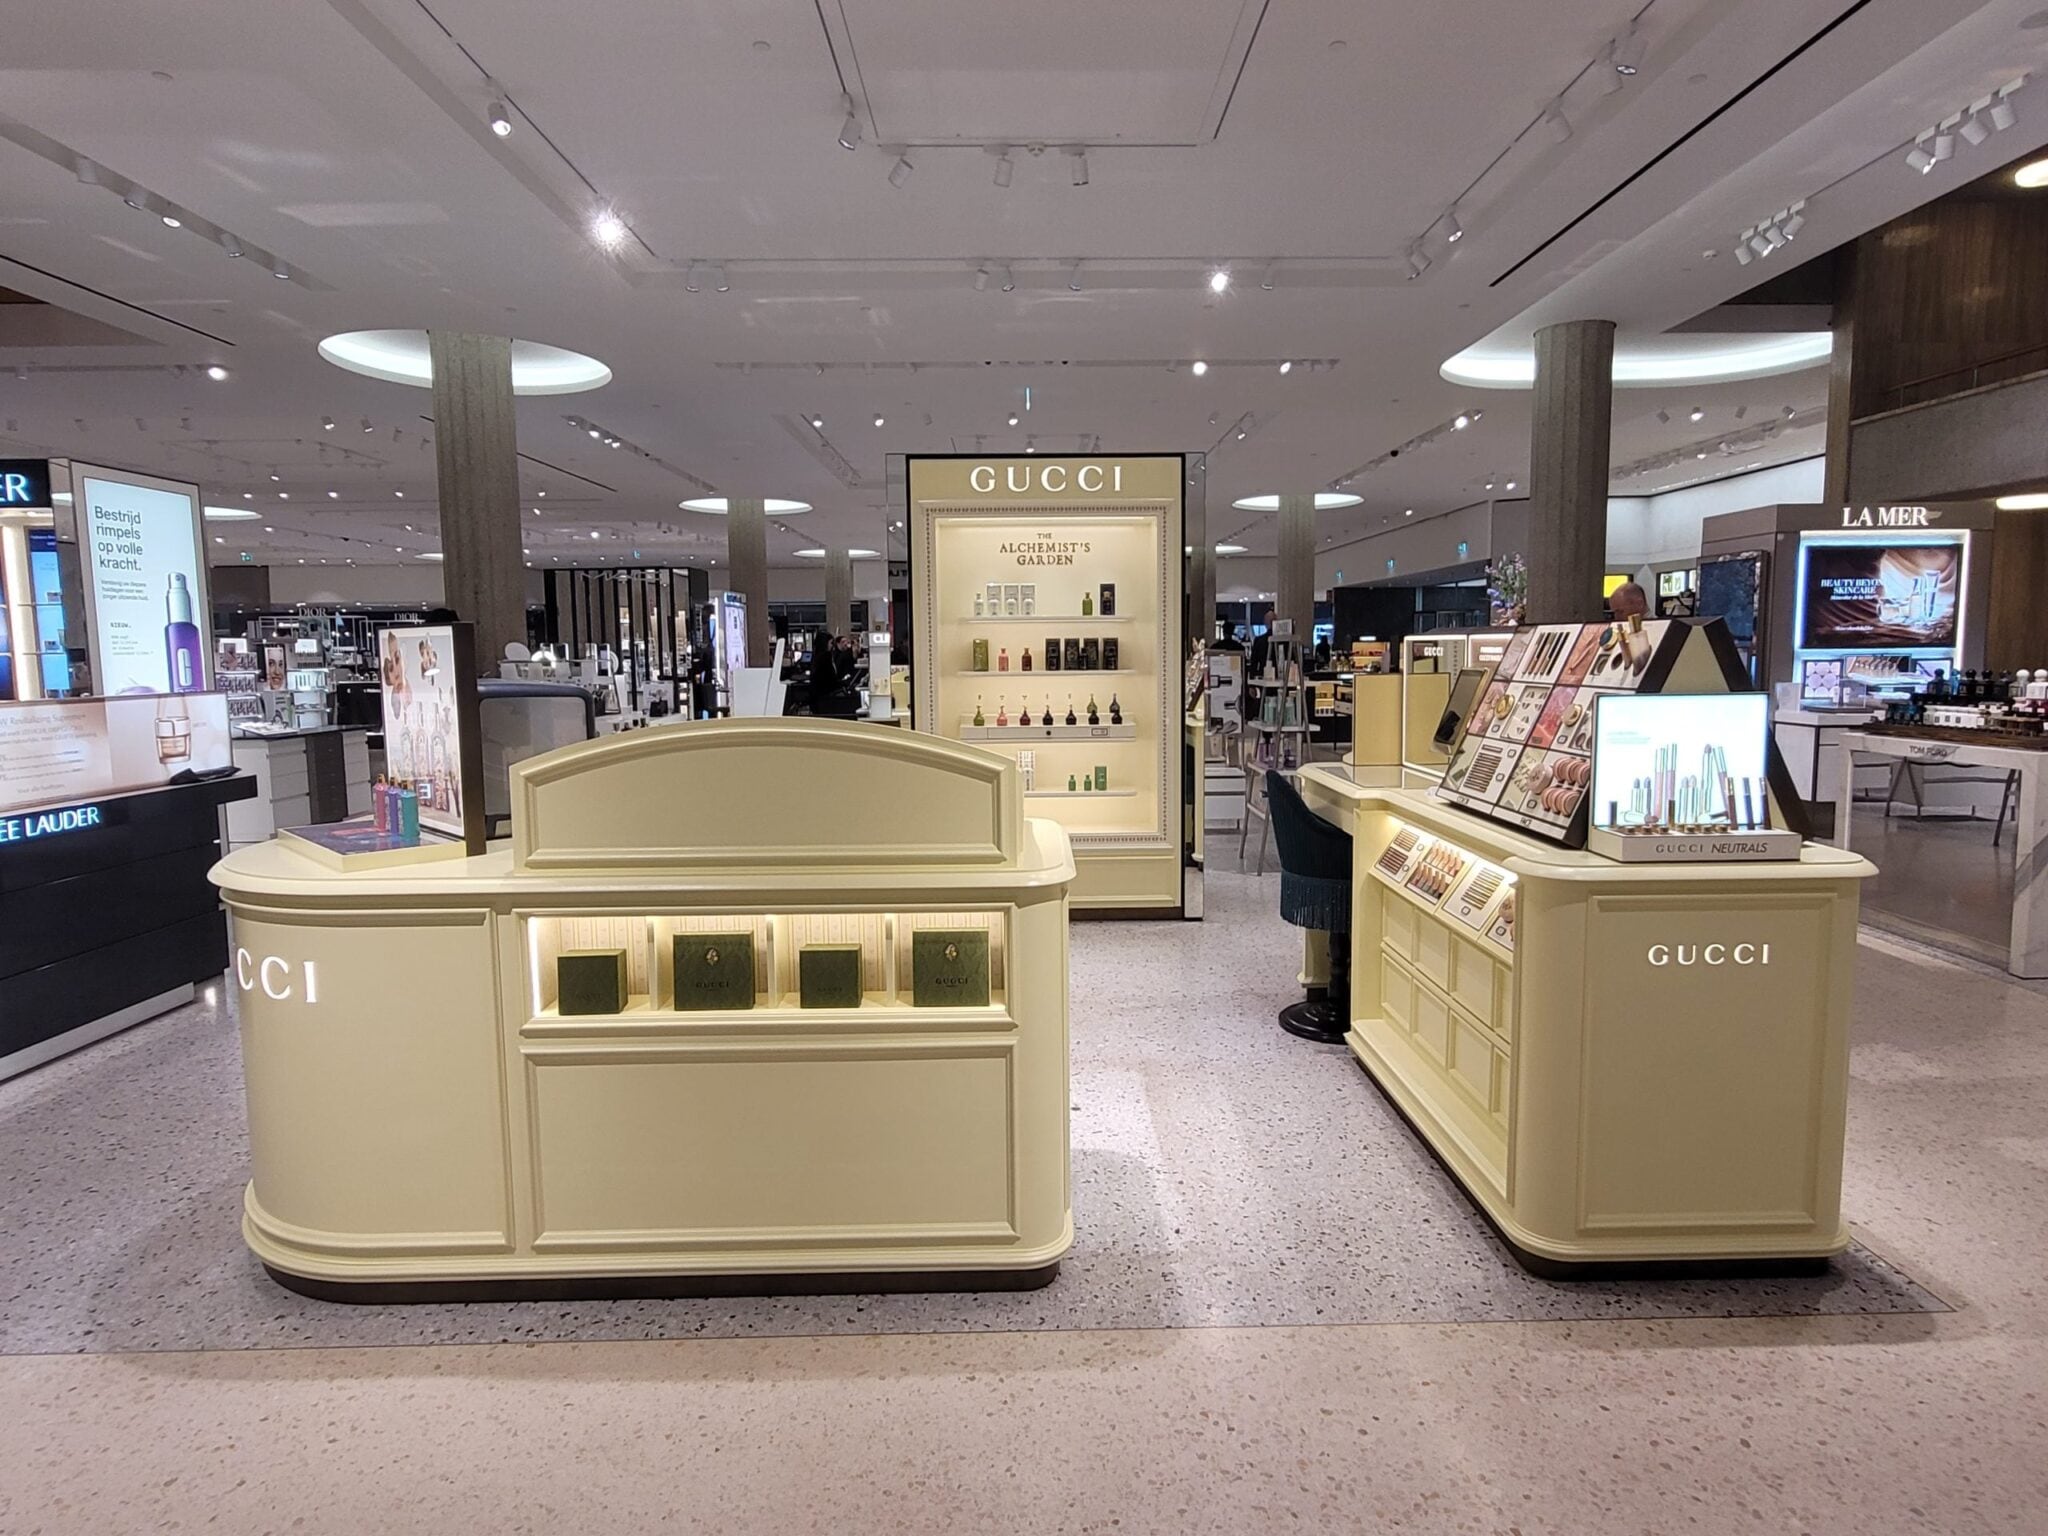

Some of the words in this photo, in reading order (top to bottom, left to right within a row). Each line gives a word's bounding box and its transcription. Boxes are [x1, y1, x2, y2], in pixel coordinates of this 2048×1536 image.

[969, 465, 1122, 493] GUCCI
[94, 505, 142, 526] Bestrijd
[1842, 506, 1874, 527] LA
[1877, 506, 1929, 526] MER
[96, 522, 142, 540] rimpels
[1036, 532, 1052, 540] THE
[98, 541, 114, 555] op
[115, 542, 143, 556] volle
[999, 541, 1091, 553] ALCHEMIST'S
[98, 554, 142, 571] kracht.
[1016, 554, 1074, 566] GARDEN
[1821, 579, 1856, 587] BEAUTY
[1833, 586, 1876, 595] SKINCARE
[299, 607, 327, 617] DIOR
[394, 612, 419, 621] DIOR
[1424, 646, 1444, 656] GUCCI
[1909, 745, 1926, 754] TOM
[24, 806, 100, 838] LAUDER
[1655, 843, 1704, 854] GUCCI
[1711, 842, 1769, 854] NEUTRALS
[1647, 943, 1769, 966] GUCCI
[695, 980, 729, 989] GUCCI
[935, 976, 968, 985] GUCCI
